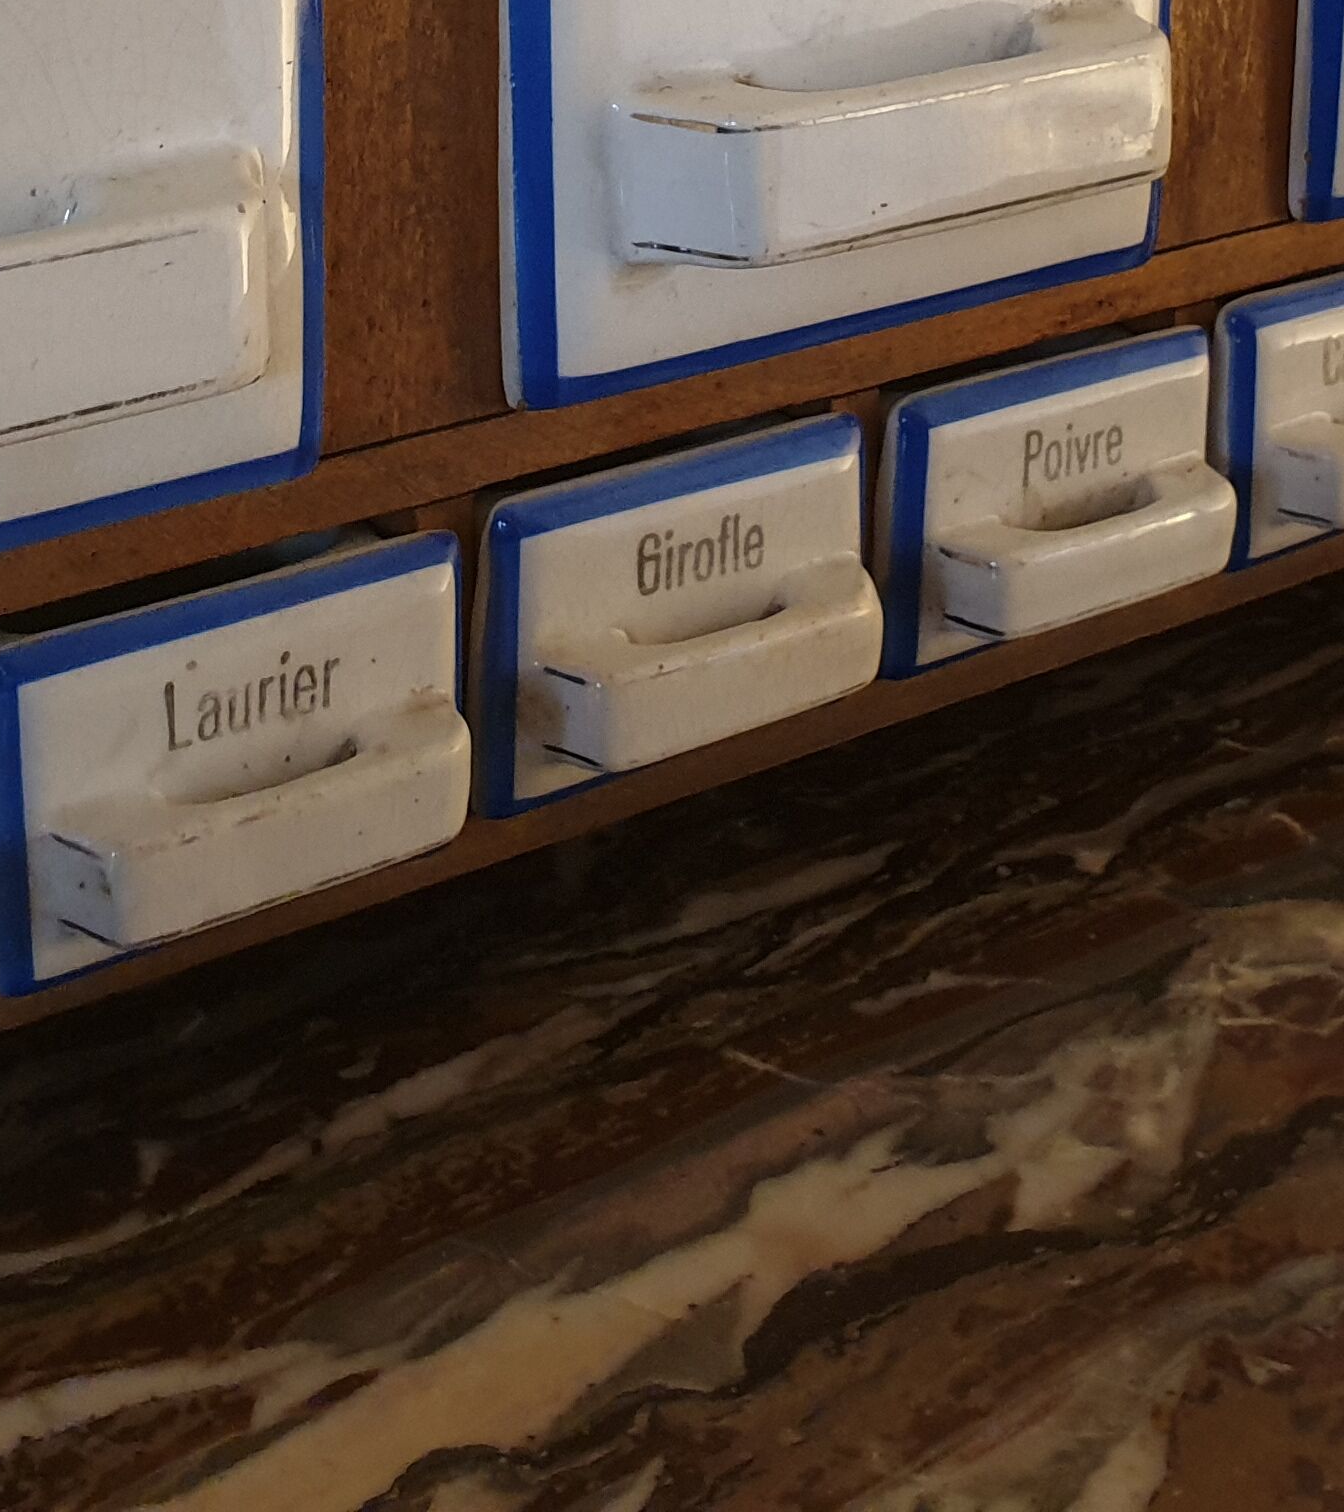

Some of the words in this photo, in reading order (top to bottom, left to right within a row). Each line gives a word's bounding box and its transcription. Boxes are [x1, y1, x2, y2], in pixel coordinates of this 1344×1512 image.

[1022, 423, 1124, 488] Poivre
[636, 513, 765, 596] Girofle
[164, 650, 341, 752] Laurier
